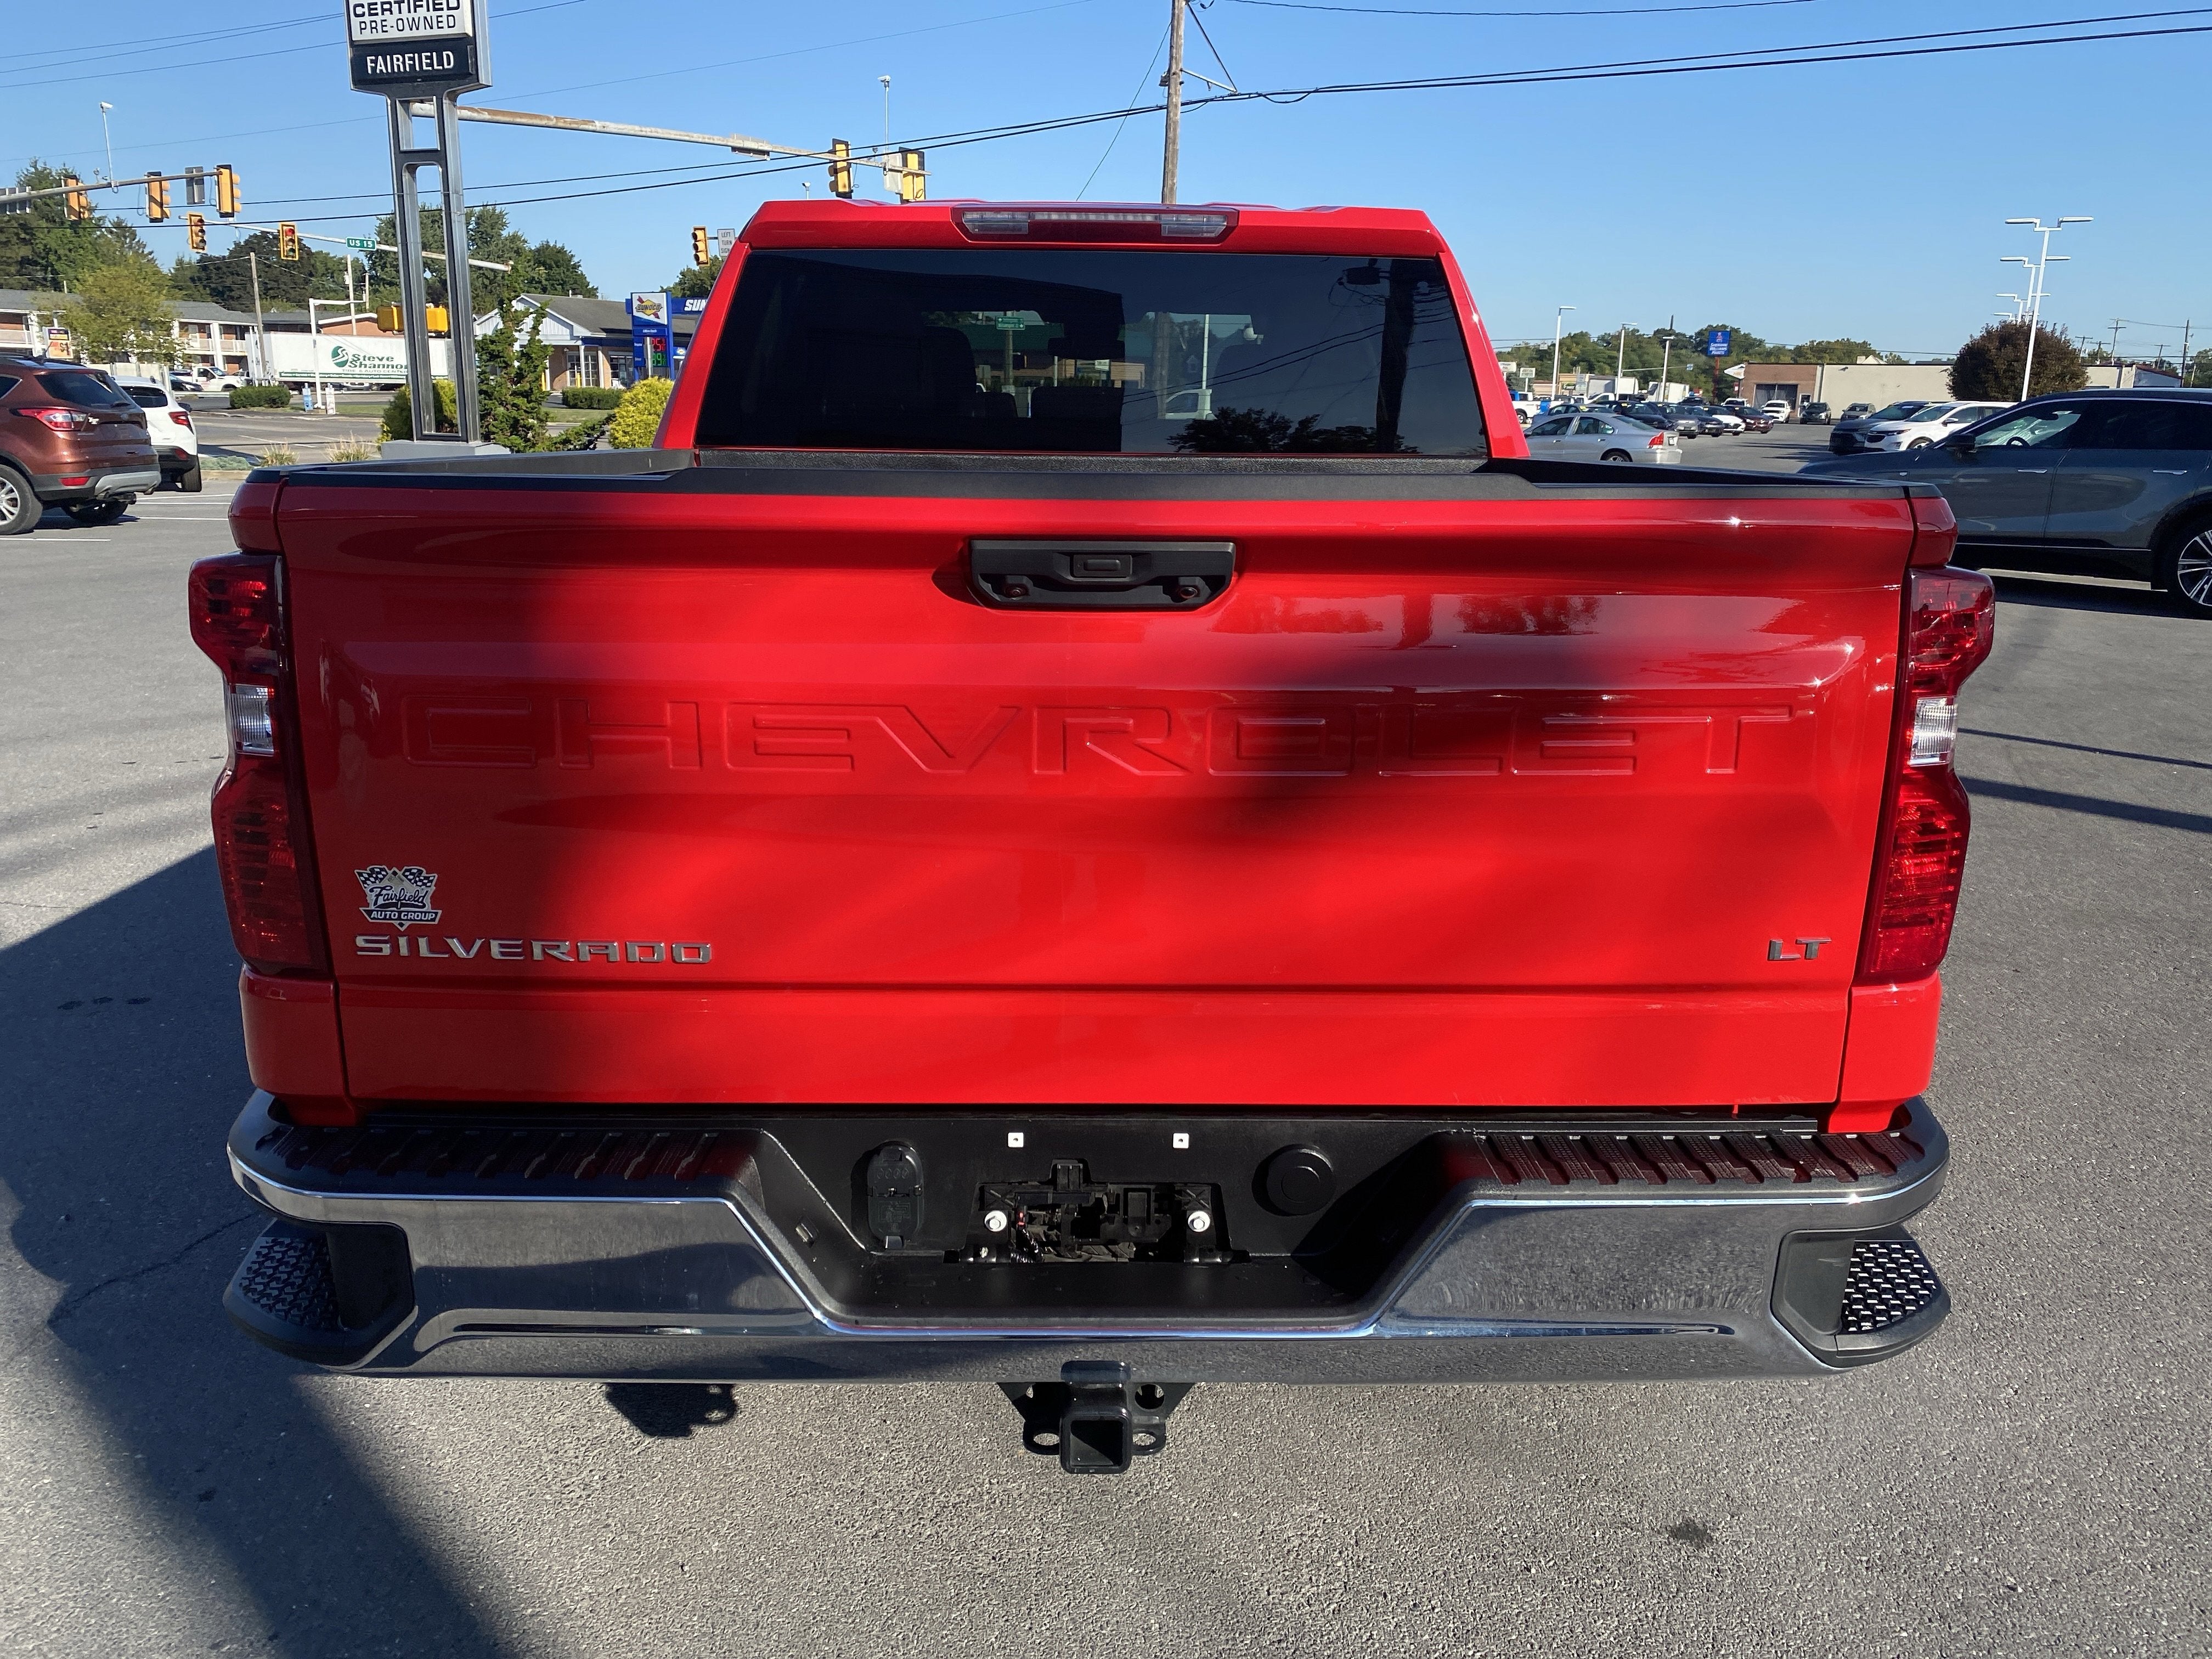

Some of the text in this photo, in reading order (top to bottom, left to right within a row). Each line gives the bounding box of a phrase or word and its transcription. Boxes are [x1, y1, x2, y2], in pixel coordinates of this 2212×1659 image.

[352, 0, 460, 18] CERTIFIED
[359, 14, 456, 35] PRE-OWNED
[366, 50, 454, 75] FAIRFIELD
[351, 354, 394, 362] Steve
[400, 695, 1794, 777] CHEVROLET
[368, 885, 429, 907] Fairfield
[370, 911, 436, 921] AUTO GROUP
[355, 935, 712, 964] SILVERADO
[1767, 937, 1832, 962] LT
